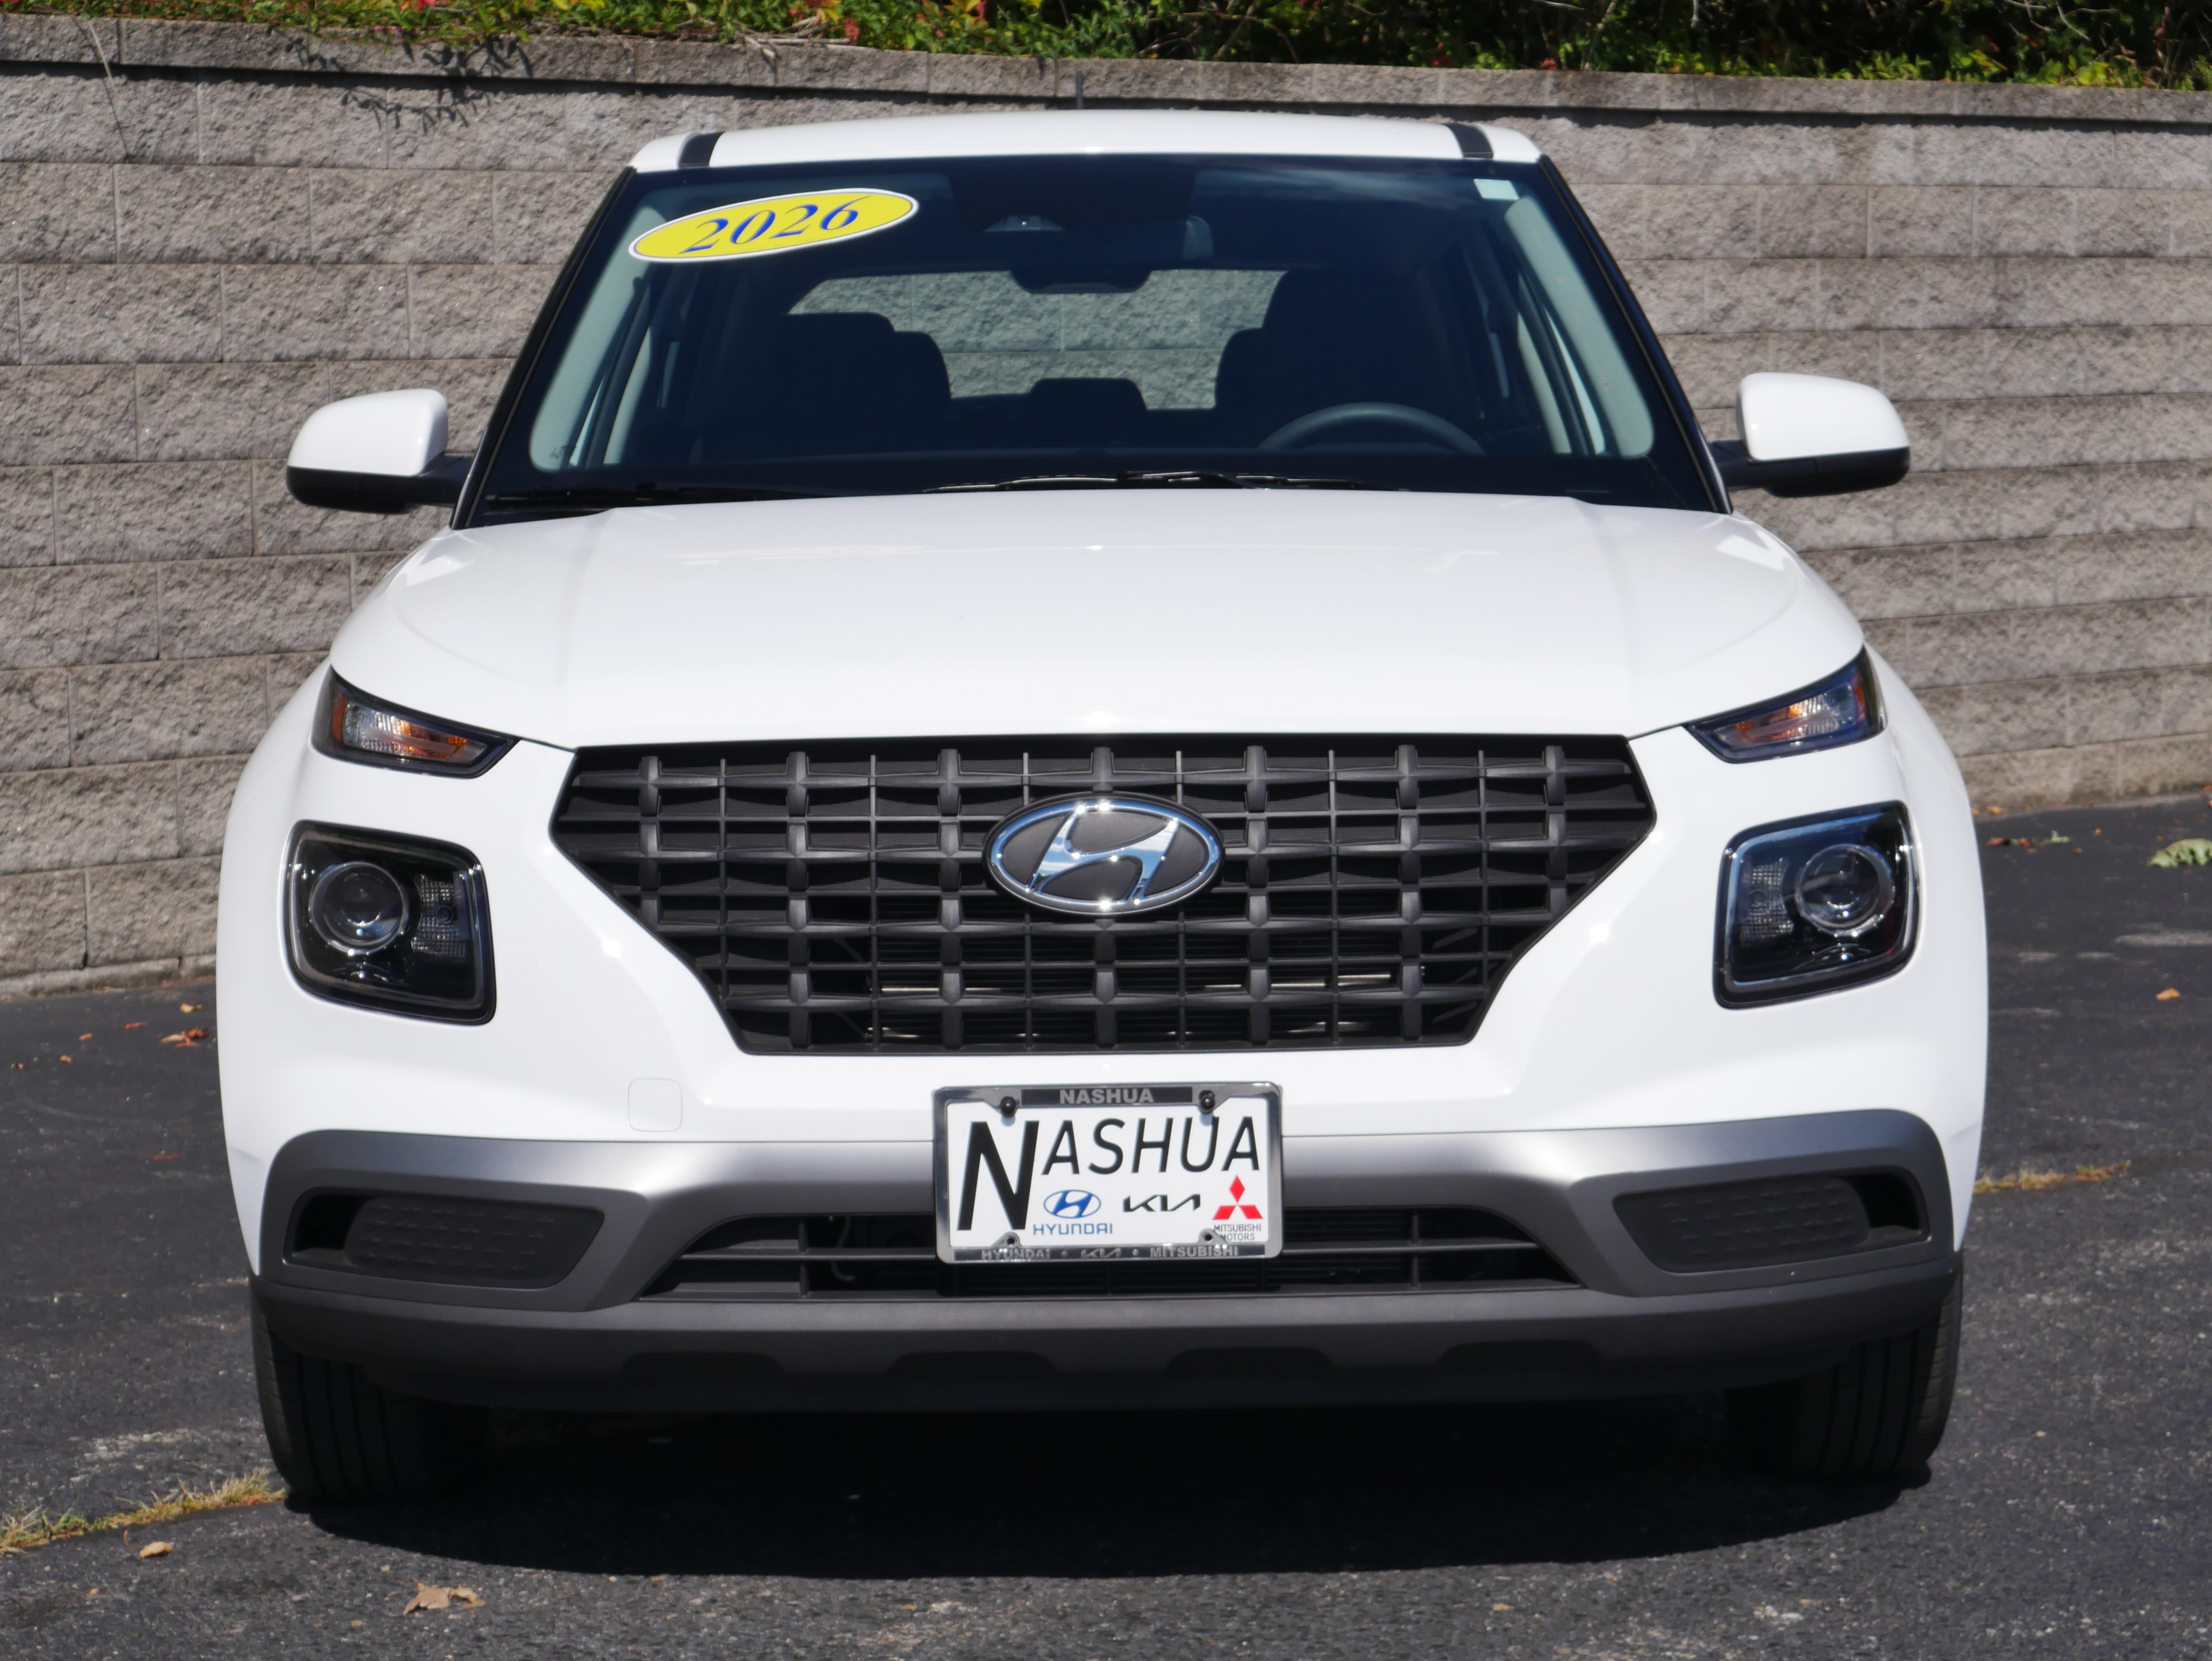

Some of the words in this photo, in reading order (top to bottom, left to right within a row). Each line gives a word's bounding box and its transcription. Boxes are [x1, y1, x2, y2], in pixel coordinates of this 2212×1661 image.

[678, 195, 871, 254] 2026
[1060, 1087, 1155, 1105] NASHUA
[956, 1116, 1260, 1231] NASHUA
[1032, 1223, 1113, 1235] HYUNDAI
[1213, 1223, 1262, 1232] MITSUBISHI
[981, 1249, 1051, 1260] HYUNDAI
[1149, 1244, 1238, 1257] MITSUBISHI
